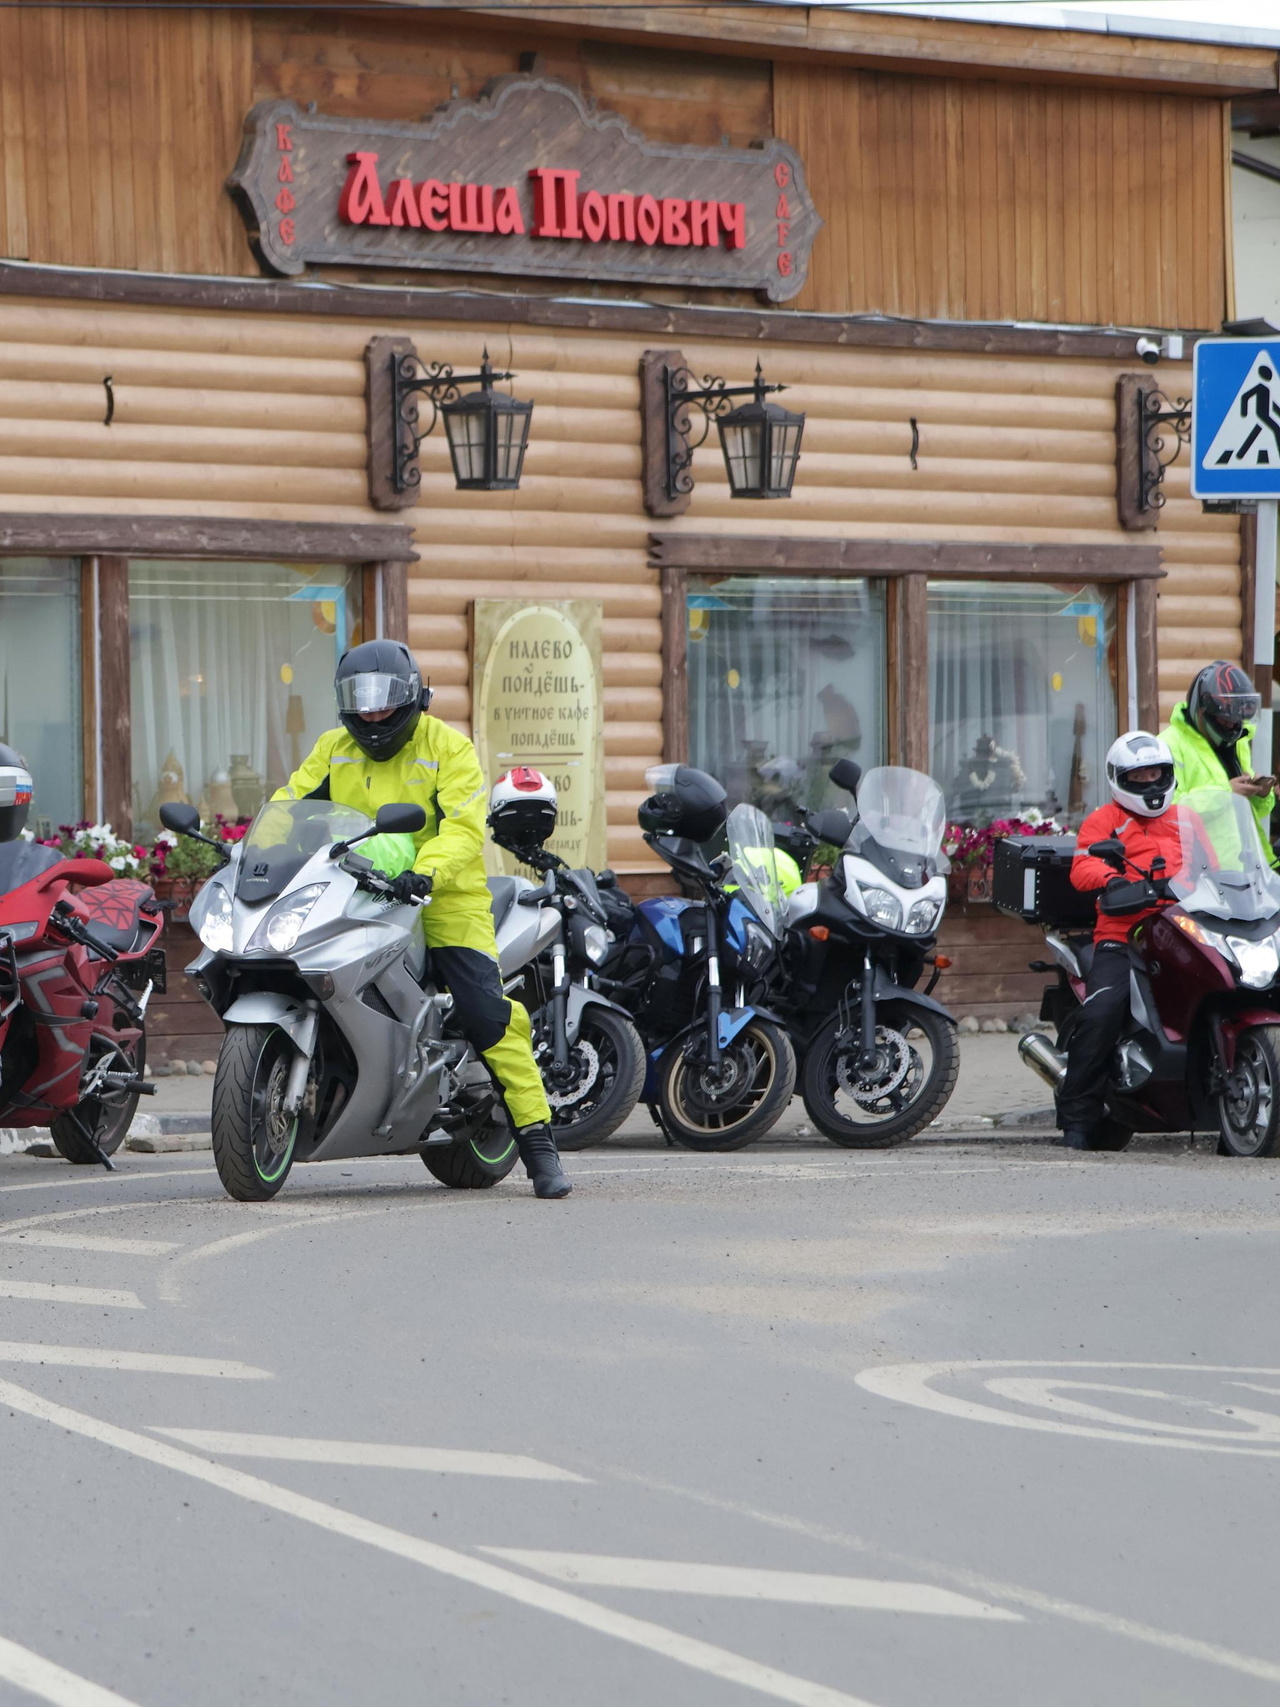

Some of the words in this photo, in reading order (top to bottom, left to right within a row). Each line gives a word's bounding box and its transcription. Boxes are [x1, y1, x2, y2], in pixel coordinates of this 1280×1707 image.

[275, 123, 296, 246] КАФЕ
[509, 640, 572, 660] НАЛЕВО
[559, 698, 589, 732] КАФЕ
